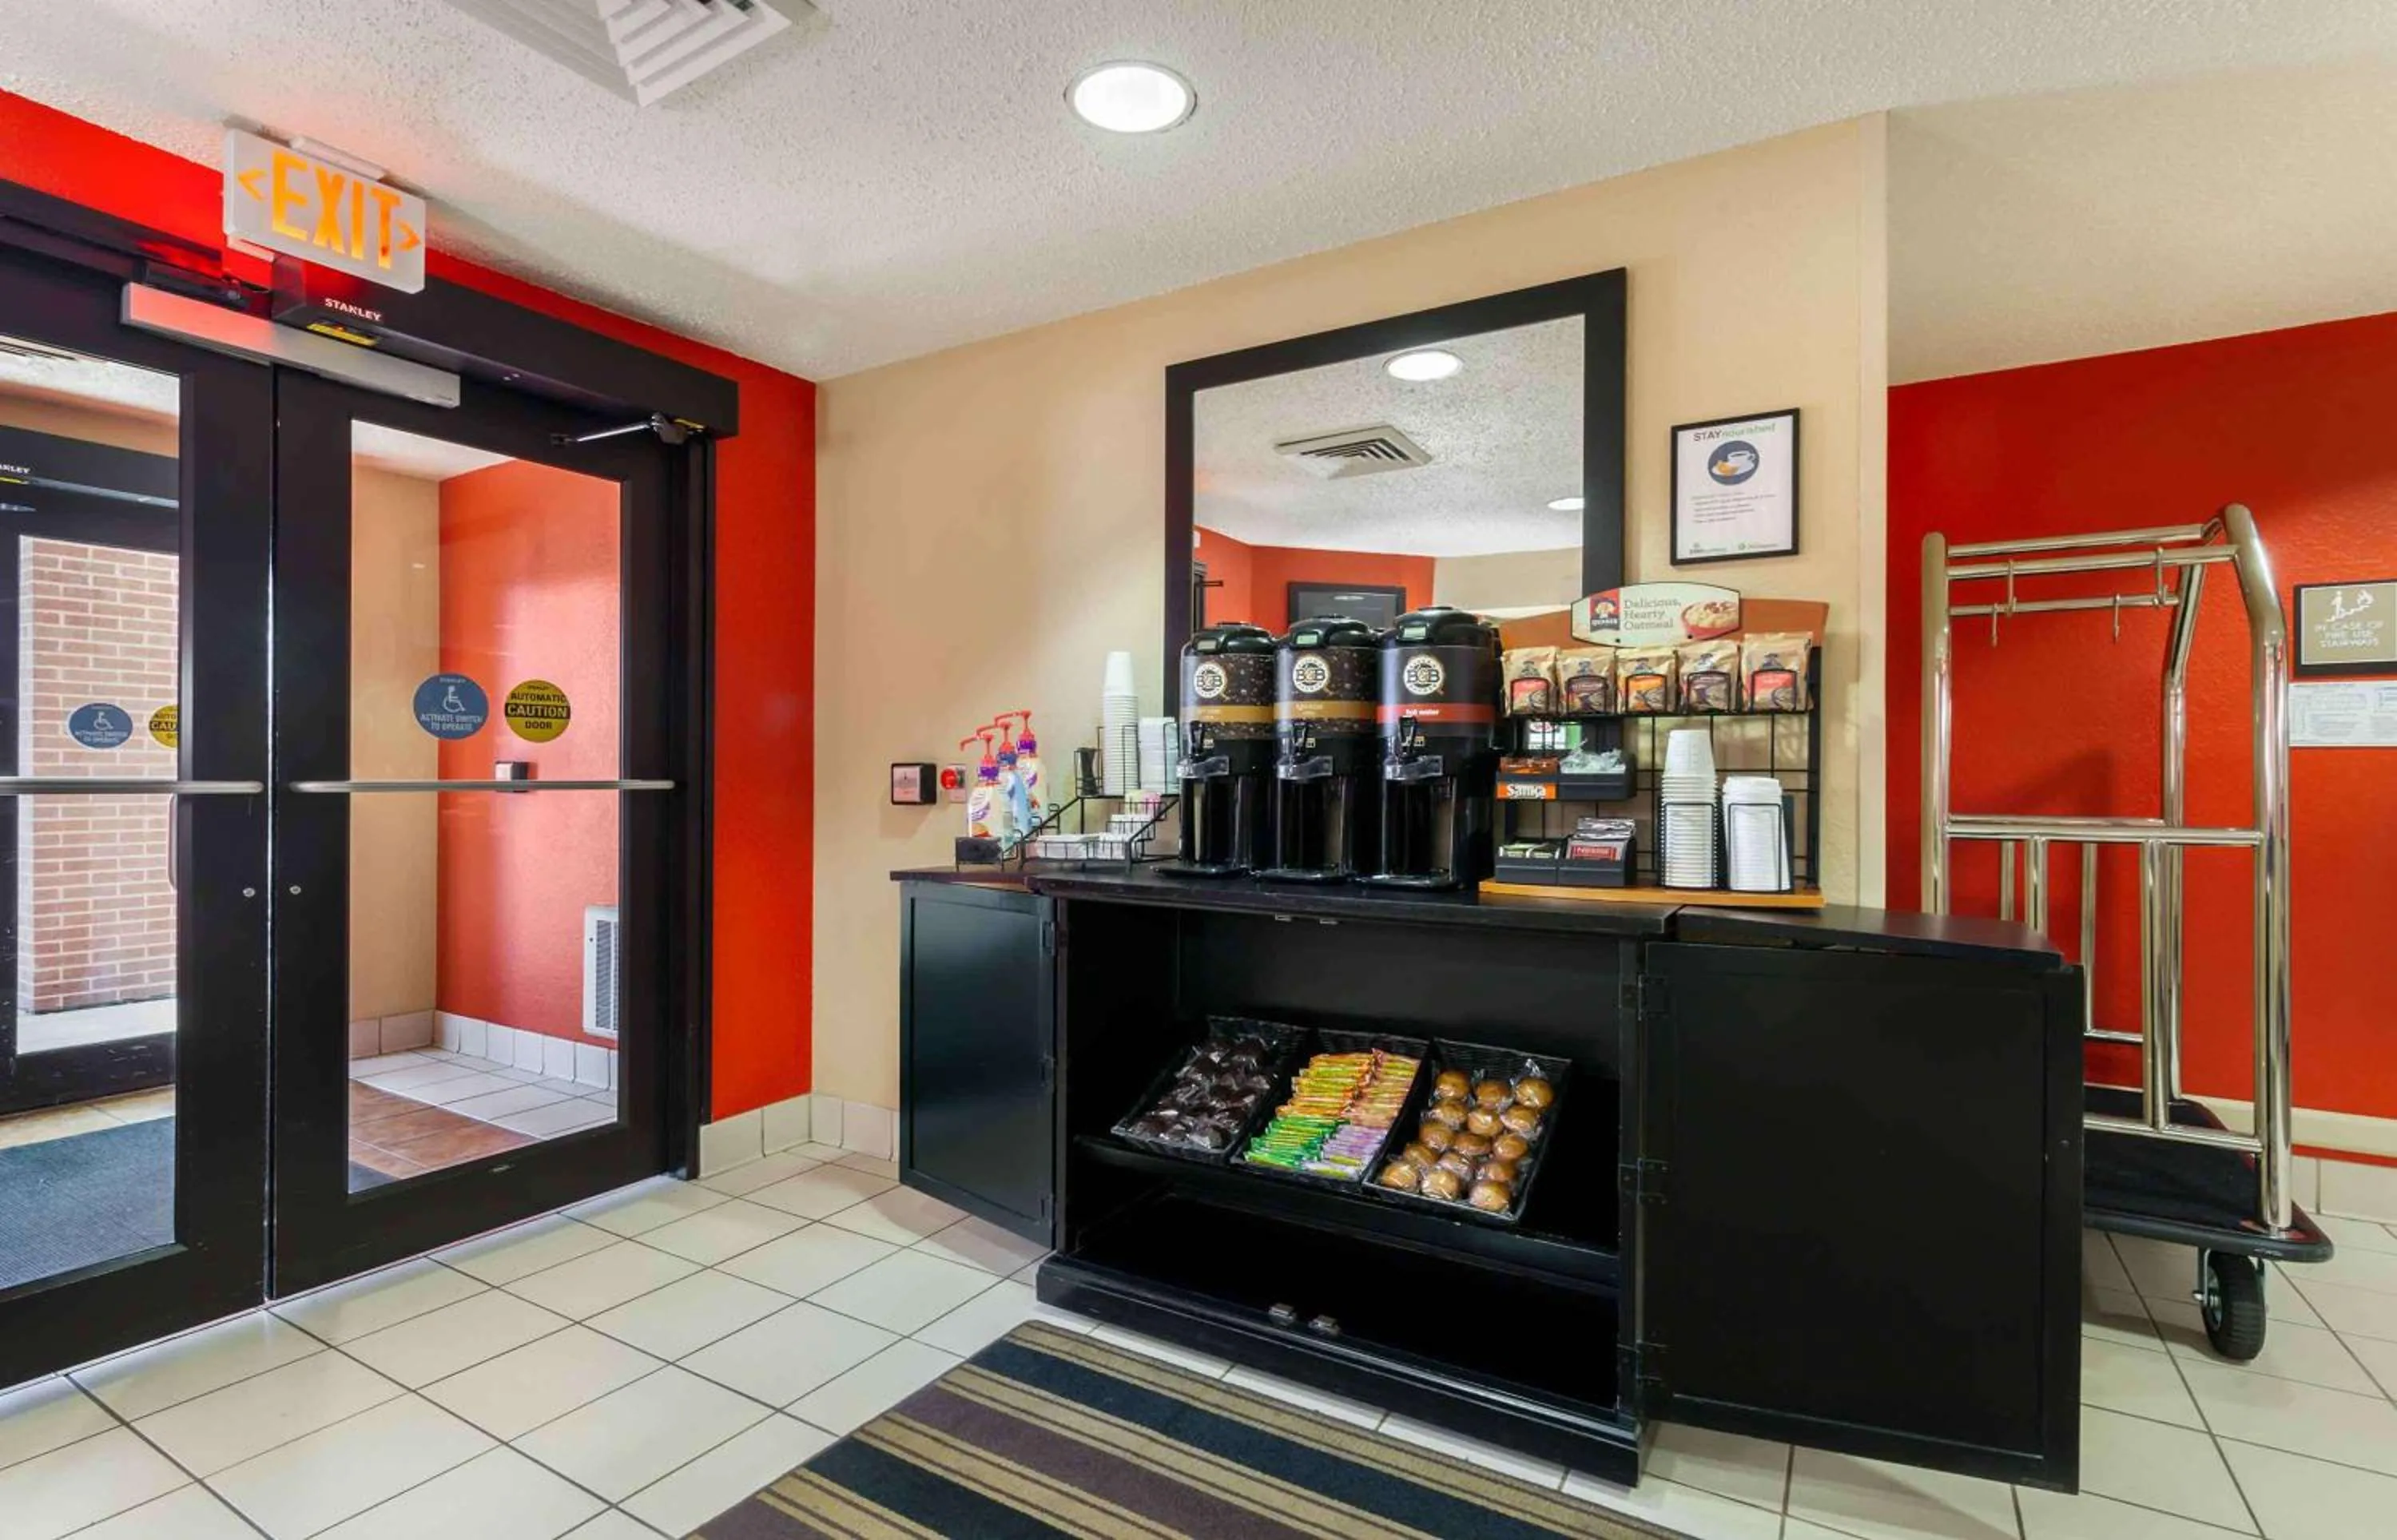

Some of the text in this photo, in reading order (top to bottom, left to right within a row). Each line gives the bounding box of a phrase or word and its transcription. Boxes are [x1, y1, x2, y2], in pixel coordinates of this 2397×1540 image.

[272, 149, 403, 270] EXIT
[324, 297, 383, 321] STANLEY
[1624, 609, 1666, 620] Hearty
[1624, 619, 1674, 630] Oatmeal
[510, 692, 567, 704] AUTOMATIC
[507, 704, 567, 719] CAUTION
[524, 720, 553, 729] DOOR
